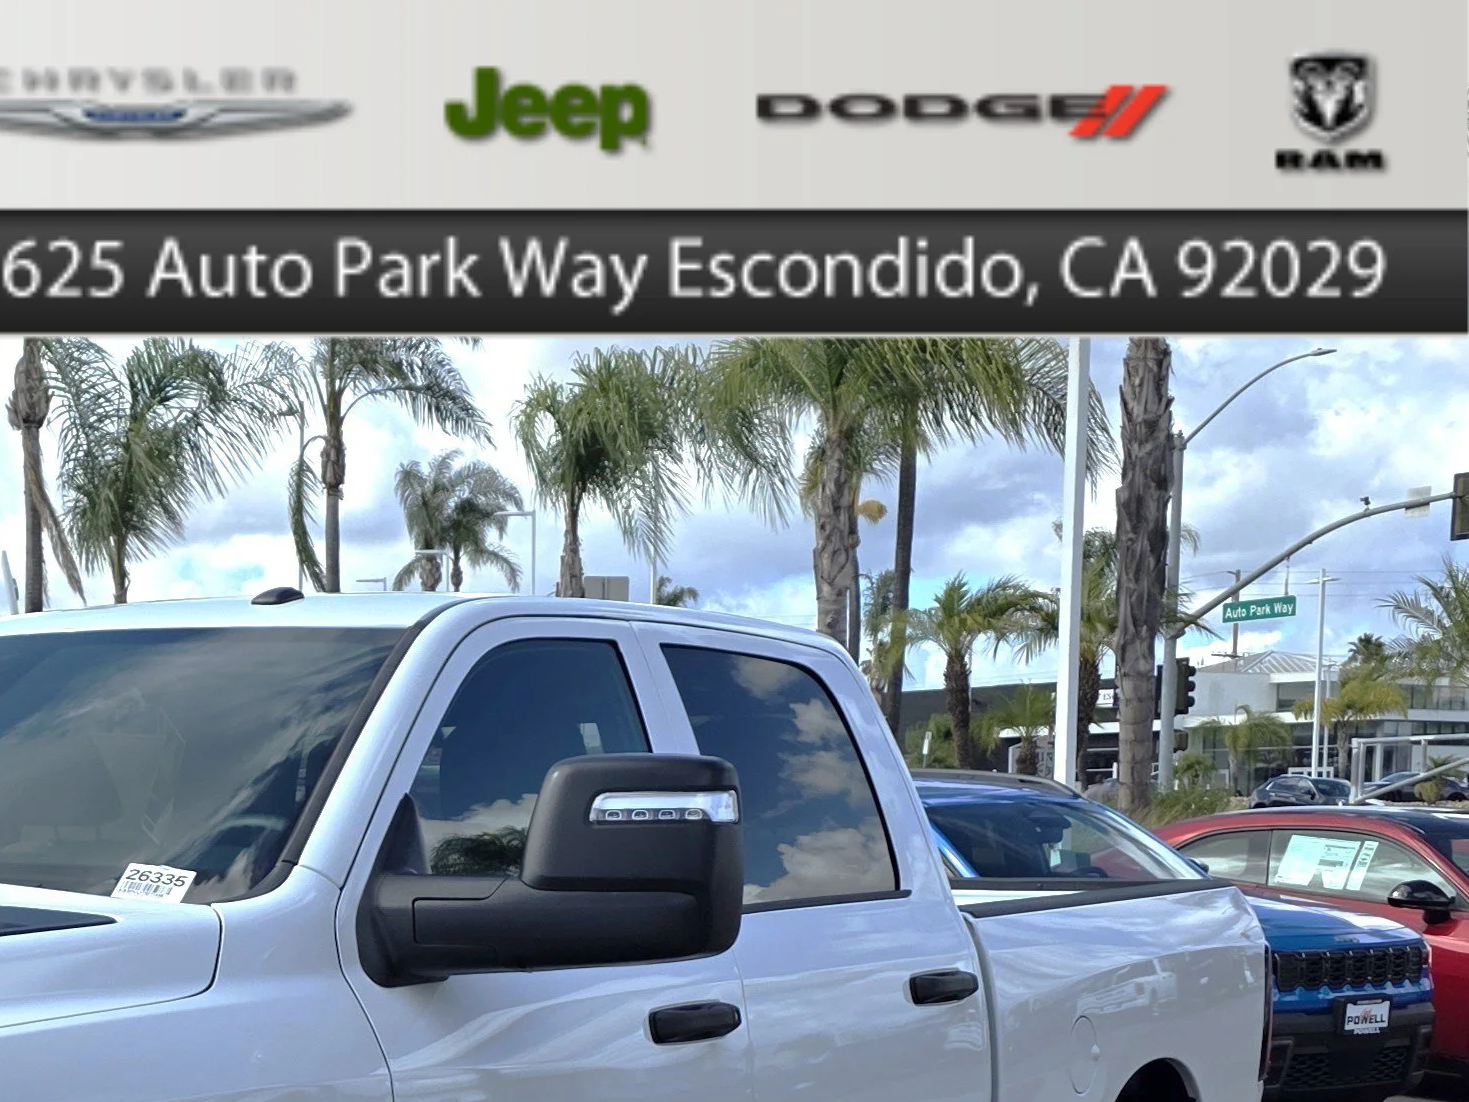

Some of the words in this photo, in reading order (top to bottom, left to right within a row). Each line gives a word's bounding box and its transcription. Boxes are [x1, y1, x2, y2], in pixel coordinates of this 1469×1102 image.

[1225, 607, 1247, 619] Auto
[1249, 604, 1271, 616] Park
[1274, 602, 1294, 614] Way
[125, 869, 189, 887] 26335
